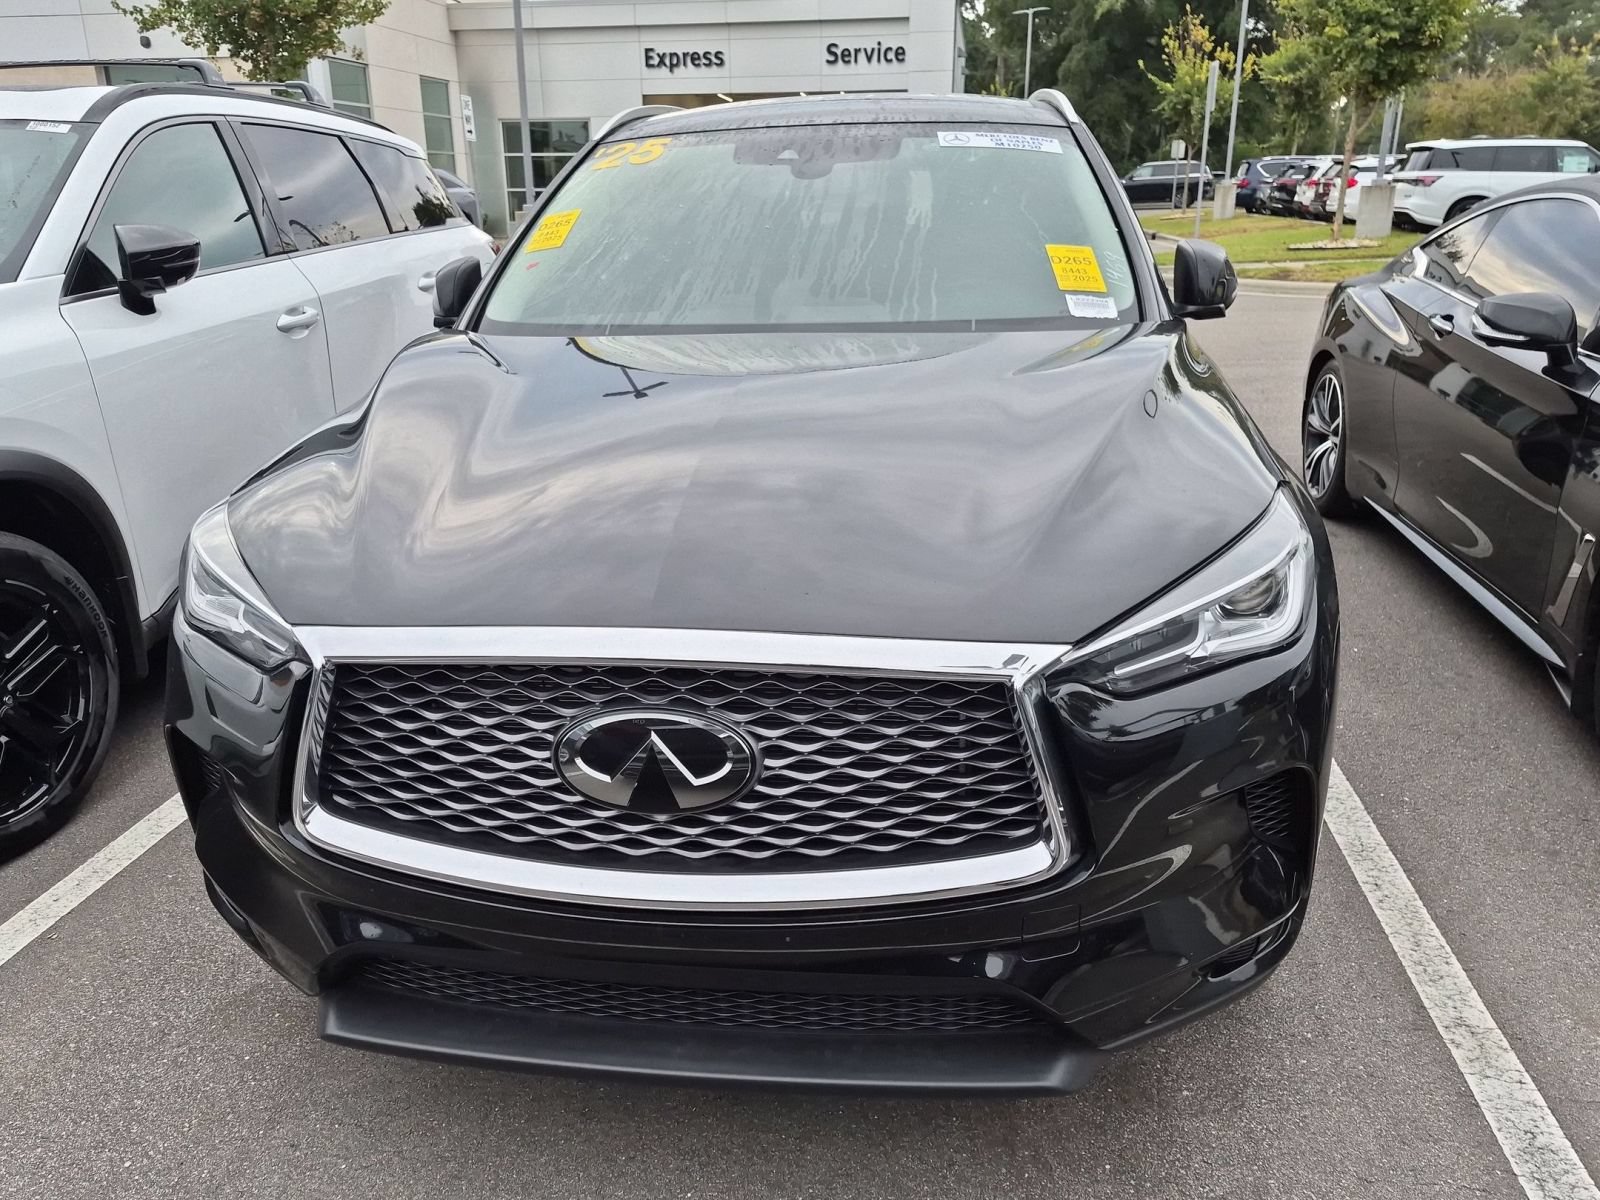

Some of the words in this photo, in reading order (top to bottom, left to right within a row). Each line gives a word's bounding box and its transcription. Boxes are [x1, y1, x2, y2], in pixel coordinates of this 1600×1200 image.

[644, 48, 725, 73] Express
[825, 41, 906, 66] Service
[1050, 255, 1092, 266] D265
